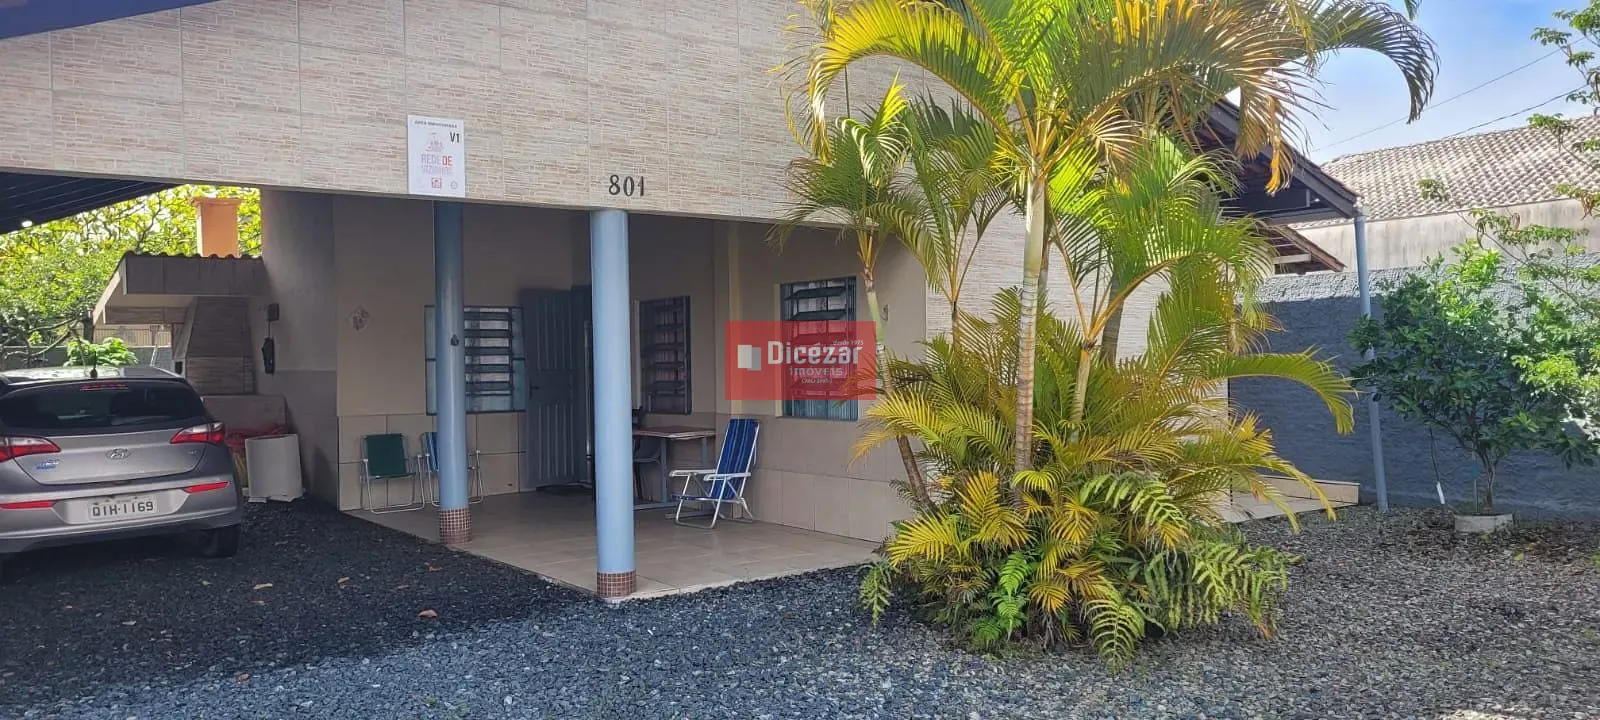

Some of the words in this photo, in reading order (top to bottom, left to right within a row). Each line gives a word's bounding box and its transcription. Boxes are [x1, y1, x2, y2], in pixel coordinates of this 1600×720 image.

[449, 132, 460, 143] V1
[442, 156, 453, 166] DE
[609, 174, 644, 196] 801
